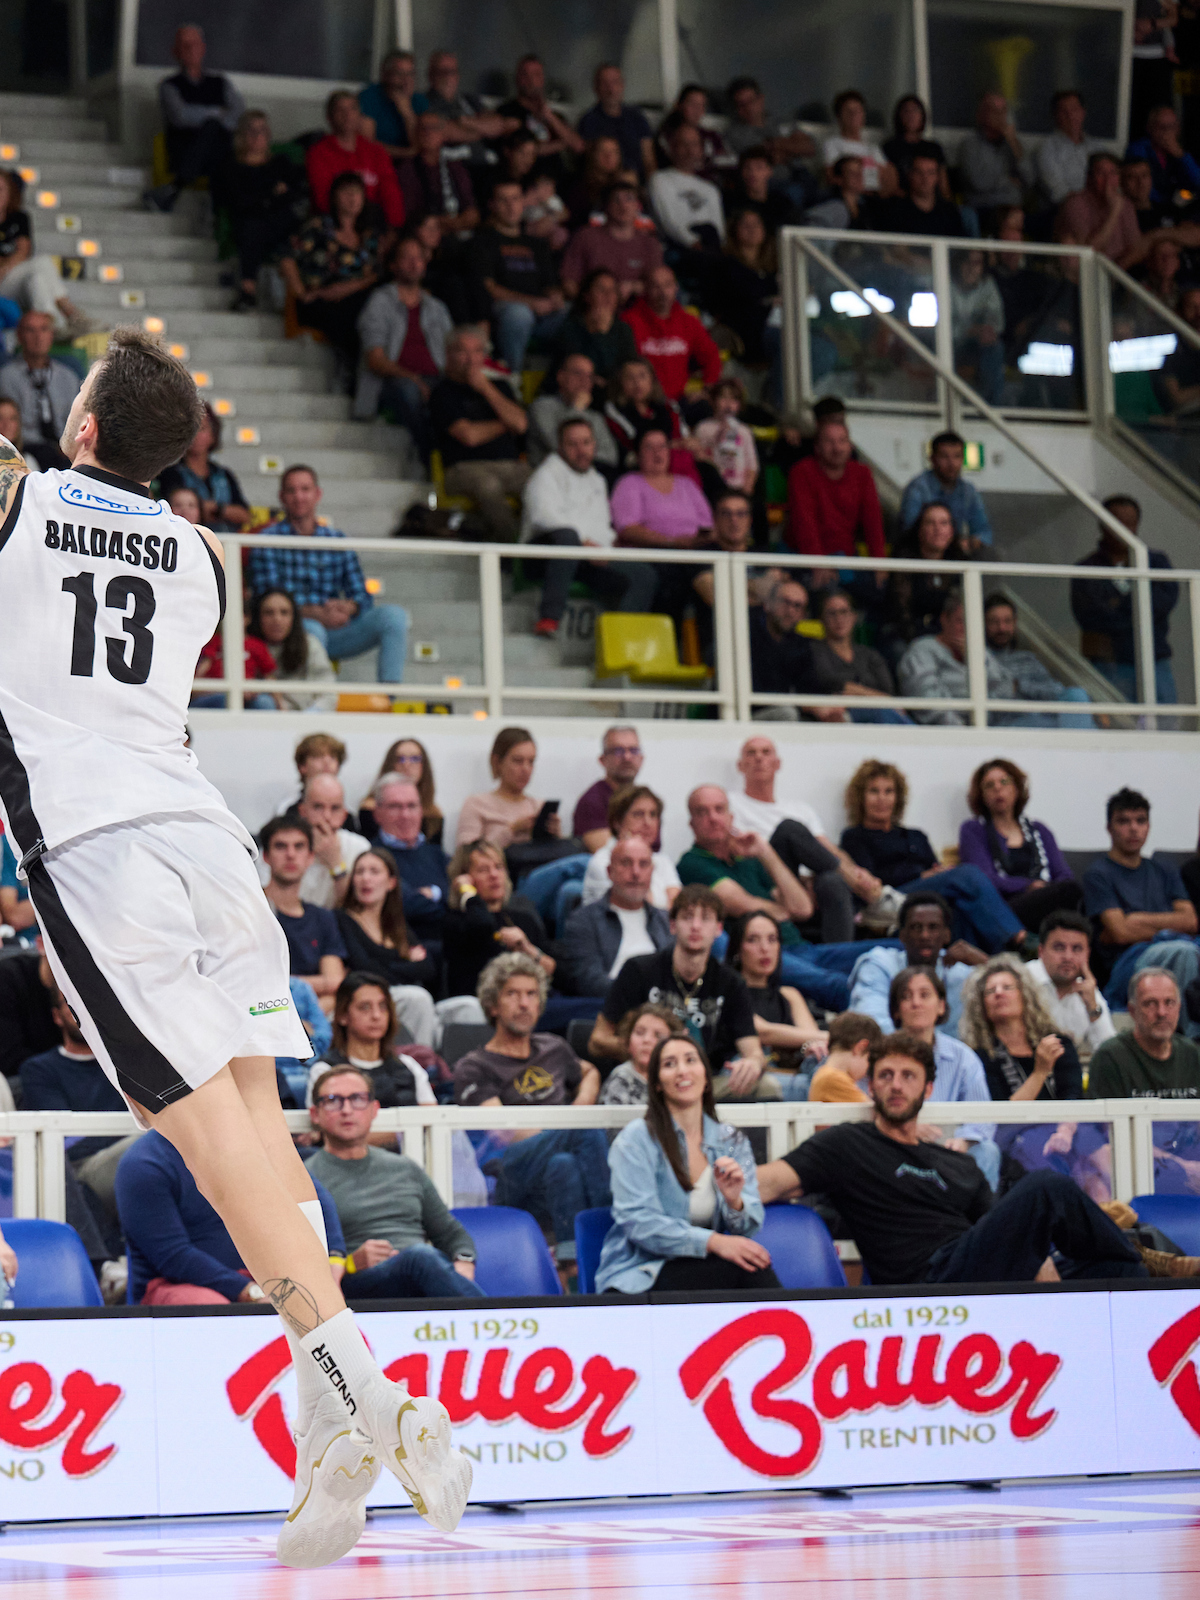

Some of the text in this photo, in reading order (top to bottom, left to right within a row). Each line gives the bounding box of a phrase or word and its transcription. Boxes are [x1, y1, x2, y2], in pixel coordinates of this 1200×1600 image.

[45, 519, 178, 573] BALDASSO
[61, 571, 157, 685] 13
[257, 997, 289, 1011] RICCO
[413, 1318, 539, 1341] dal 1929
[852, 1305, 969, 1328] dal 1929
[311, 1343, 357, 1416] UNDER
[680, 1309, 1060, 1479] Bauer
[838, 1423, 996, 1450] TRENTINO
[459, 1440, 567, 1464] NTINO
